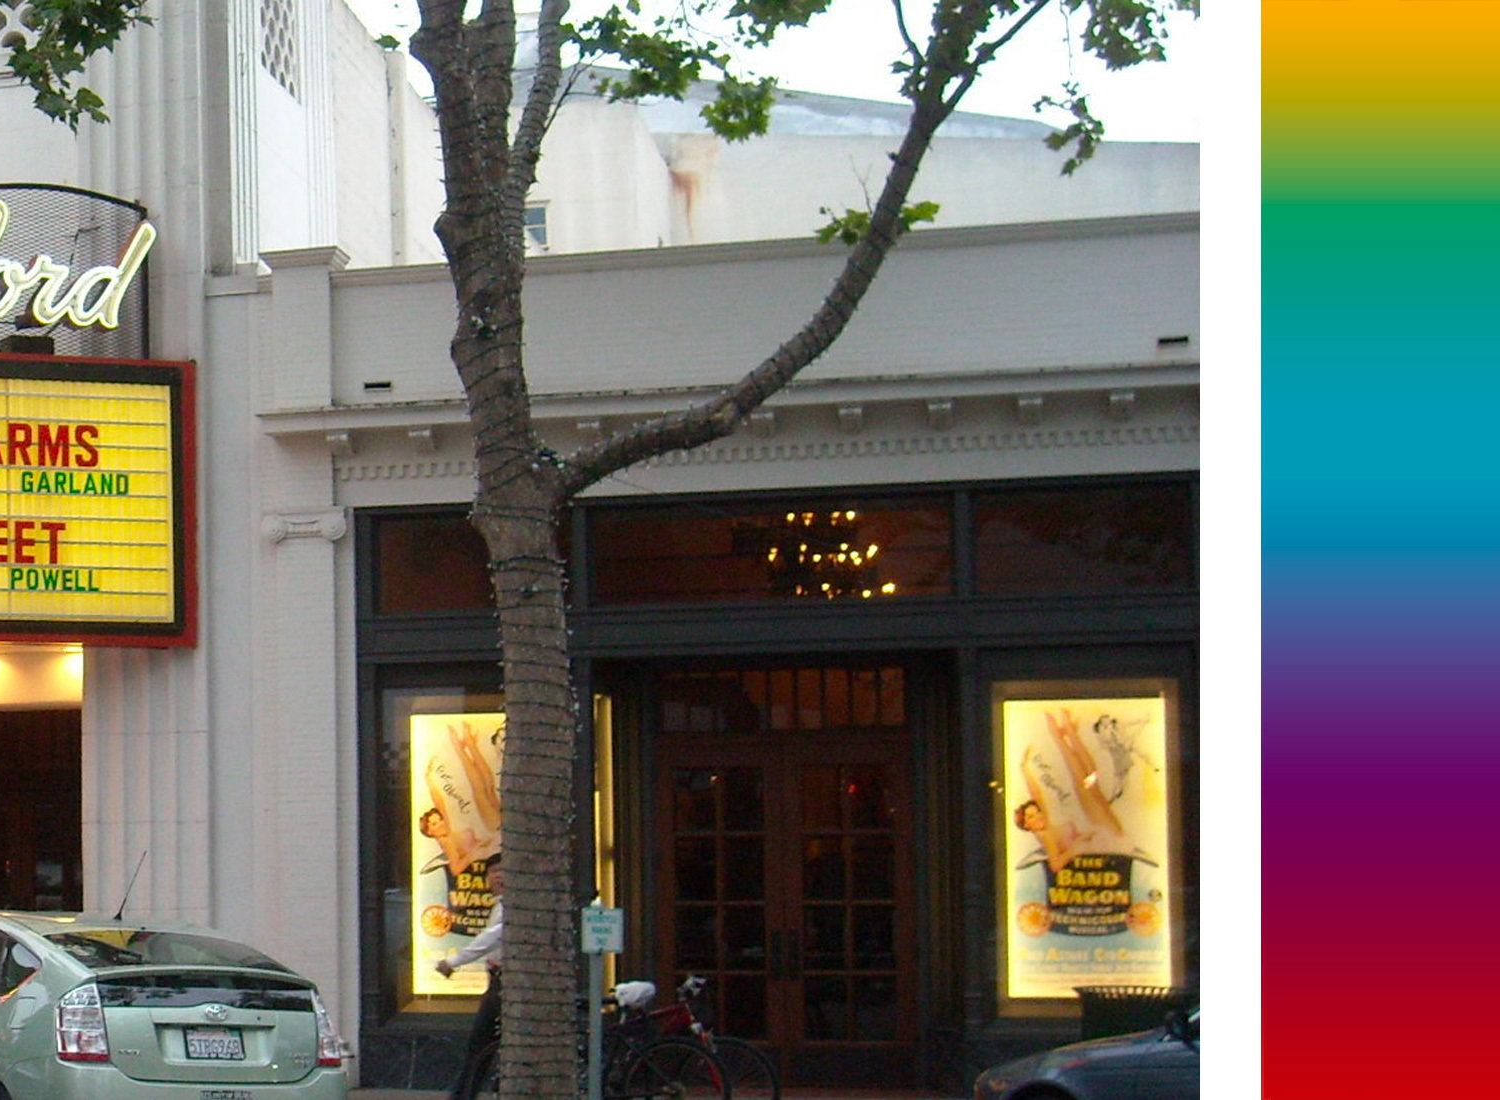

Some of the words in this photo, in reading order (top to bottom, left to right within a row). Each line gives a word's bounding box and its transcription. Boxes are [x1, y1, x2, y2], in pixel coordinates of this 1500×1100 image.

[21, 470, 129, 496] GARLAND
[10, 568, 100, 592] POWELL
[457, 873, 491, 890] BA
[1056, 869, 1121, 887] BAND
[449, 890, 494, 907] WAG
[1048, 887, 1131, 905] WAGON
